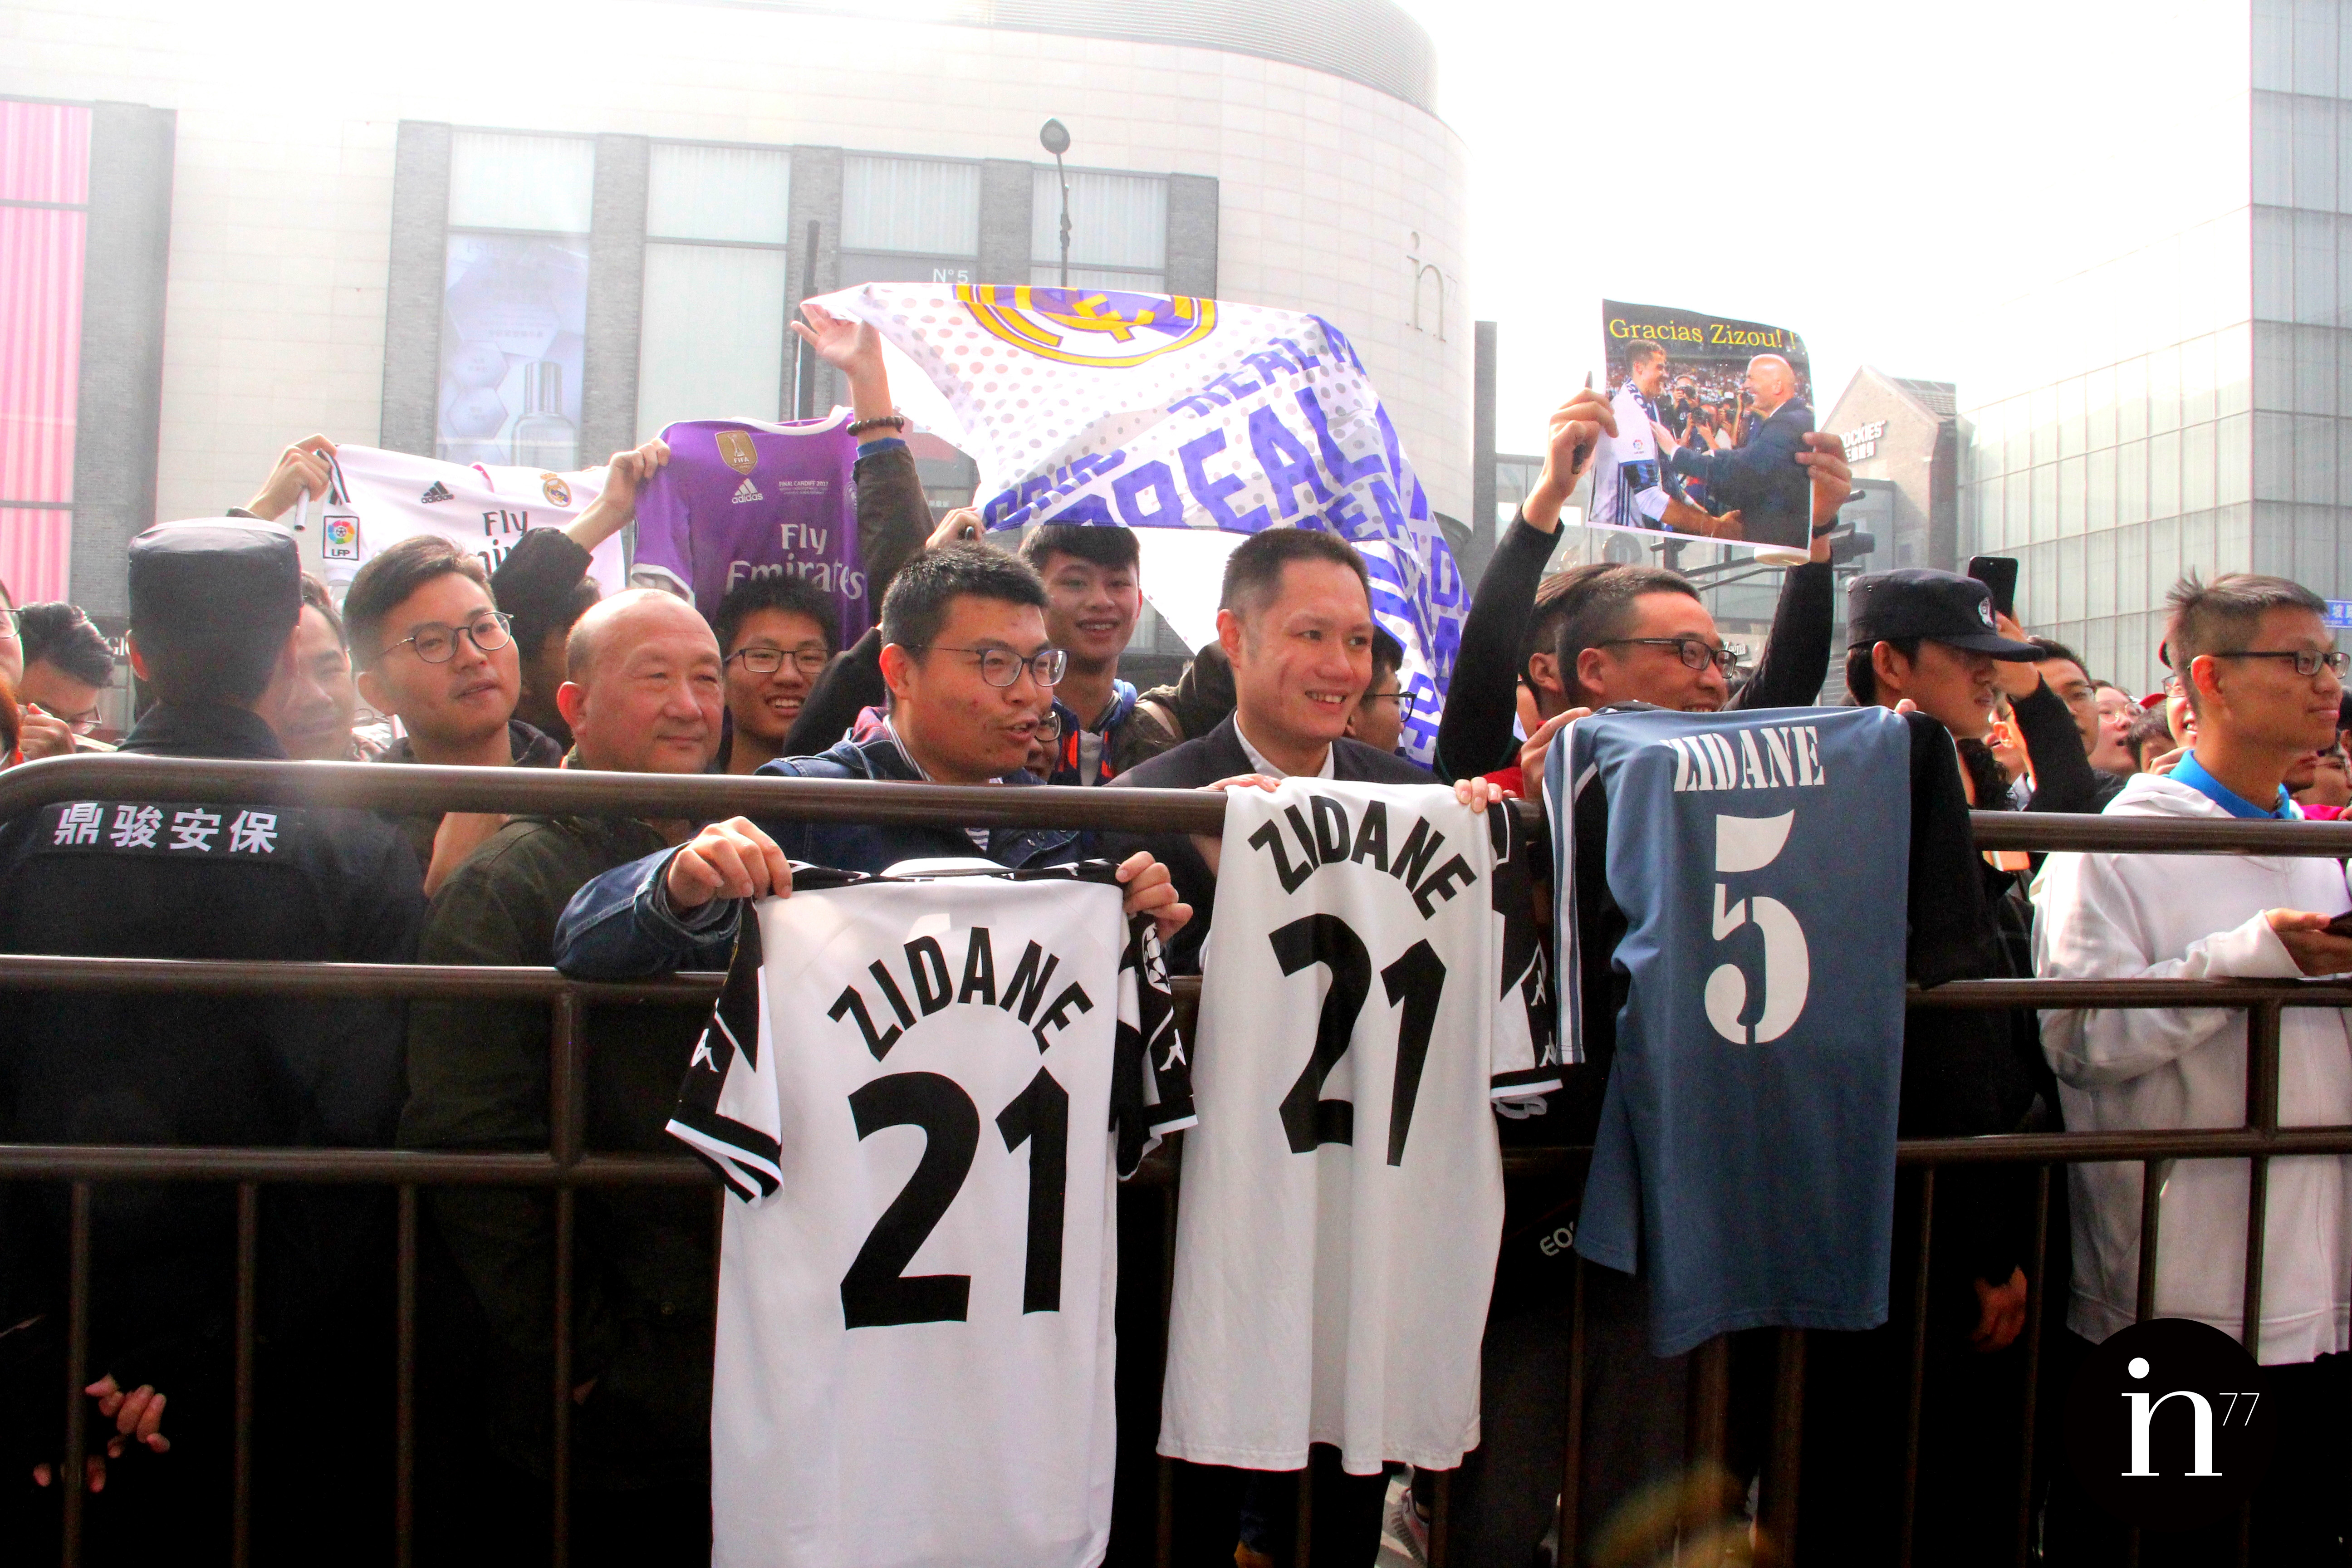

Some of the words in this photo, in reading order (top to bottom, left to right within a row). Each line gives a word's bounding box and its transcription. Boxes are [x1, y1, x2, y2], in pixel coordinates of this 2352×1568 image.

[1609, 319, 1704, 343] Gracias
[421, 493, 455, 504] adidas
[482, 510, 528, 537] Fly
[731, 492, 764, 504] adidas
[780, 523, 828, 555] Fly
[1658, 726, 1824, 793] ZIDANE
[54, 802, 279, 854] 鼎骏安保
[1248, 795, 1478, 921] ZIDANE
[1704, 809, 1810, 1045] 5
[827, 926, 1095, 1063] ZIDANE
[1268, 913, 1447, 1167] 21
[840, 1065, 1069, 1331] 21
